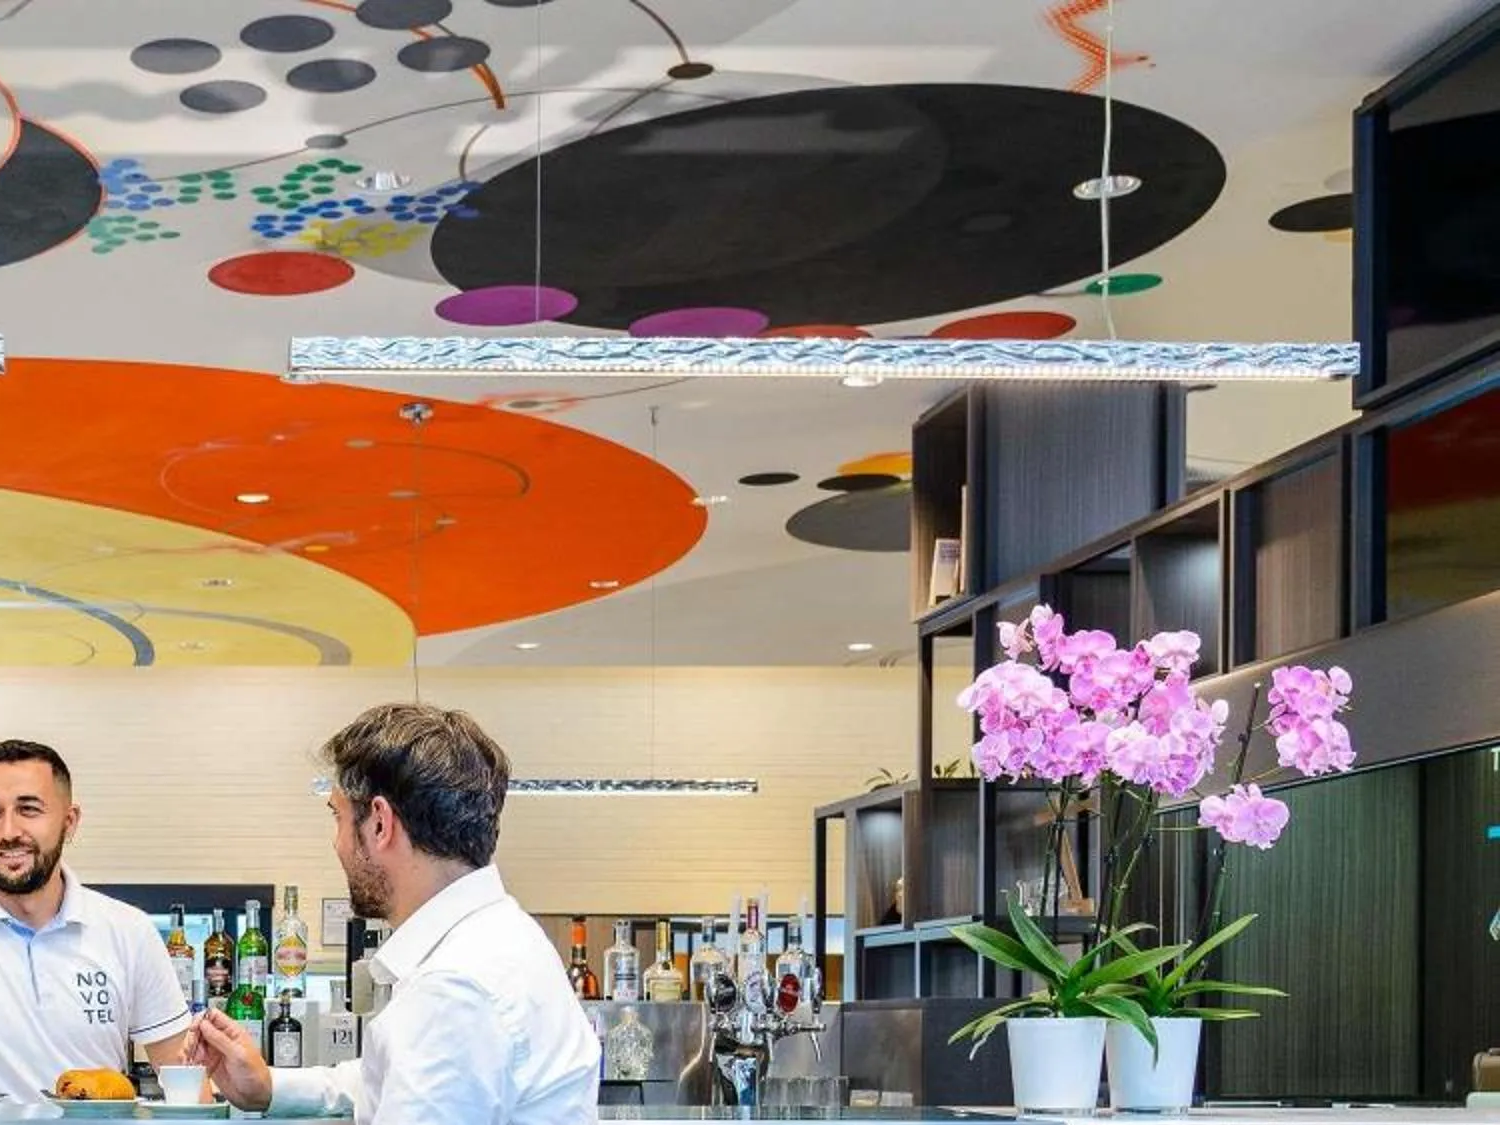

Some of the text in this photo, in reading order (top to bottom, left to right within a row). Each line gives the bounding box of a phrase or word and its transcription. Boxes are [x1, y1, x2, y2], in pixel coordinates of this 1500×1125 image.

[77, 971, 107, 987] NO
[80, 990, 109, 1004] VO
[84, 1009, 115, 1024] TEL
[332, 1029, 352, 1045] 121
